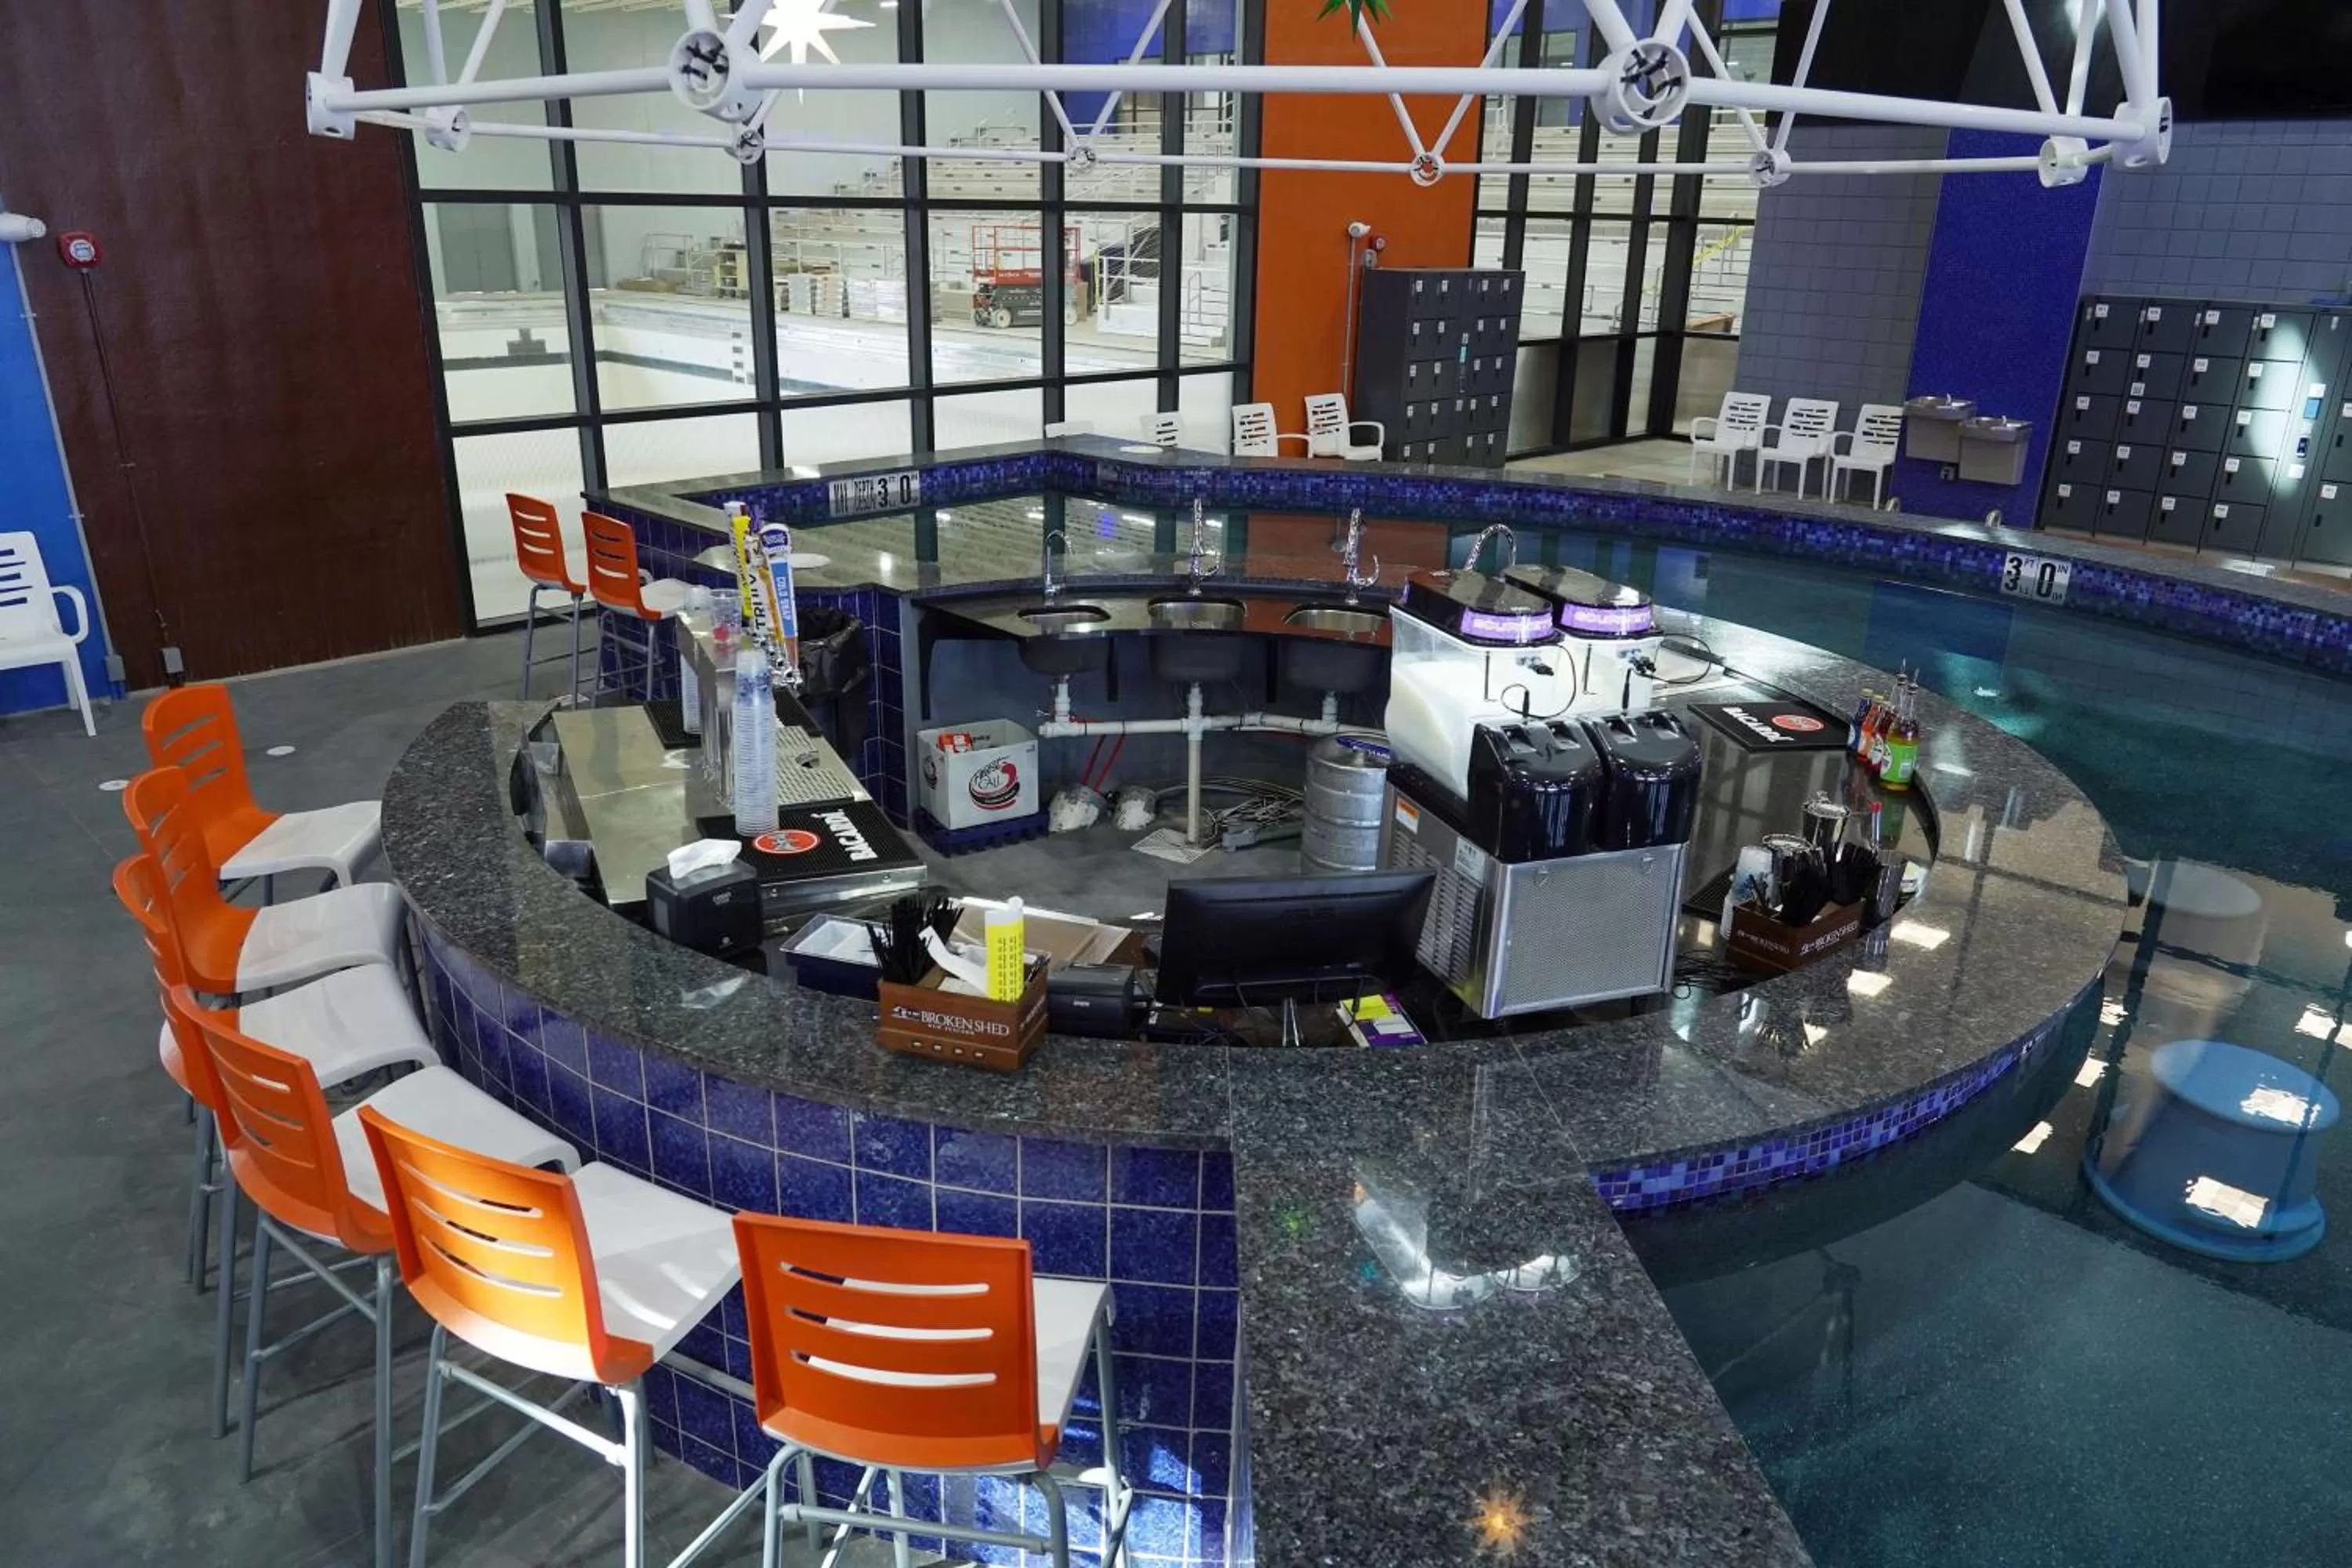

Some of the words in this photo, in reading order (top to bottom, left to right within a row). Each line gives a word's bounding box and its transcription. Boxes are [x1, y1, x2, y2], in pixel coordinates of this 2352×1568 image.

[2006, 557, 2023, 585] 3
[920, 1011, 973, 1031] BROKEN
[974, 1021, 1011, 1036] SHED
